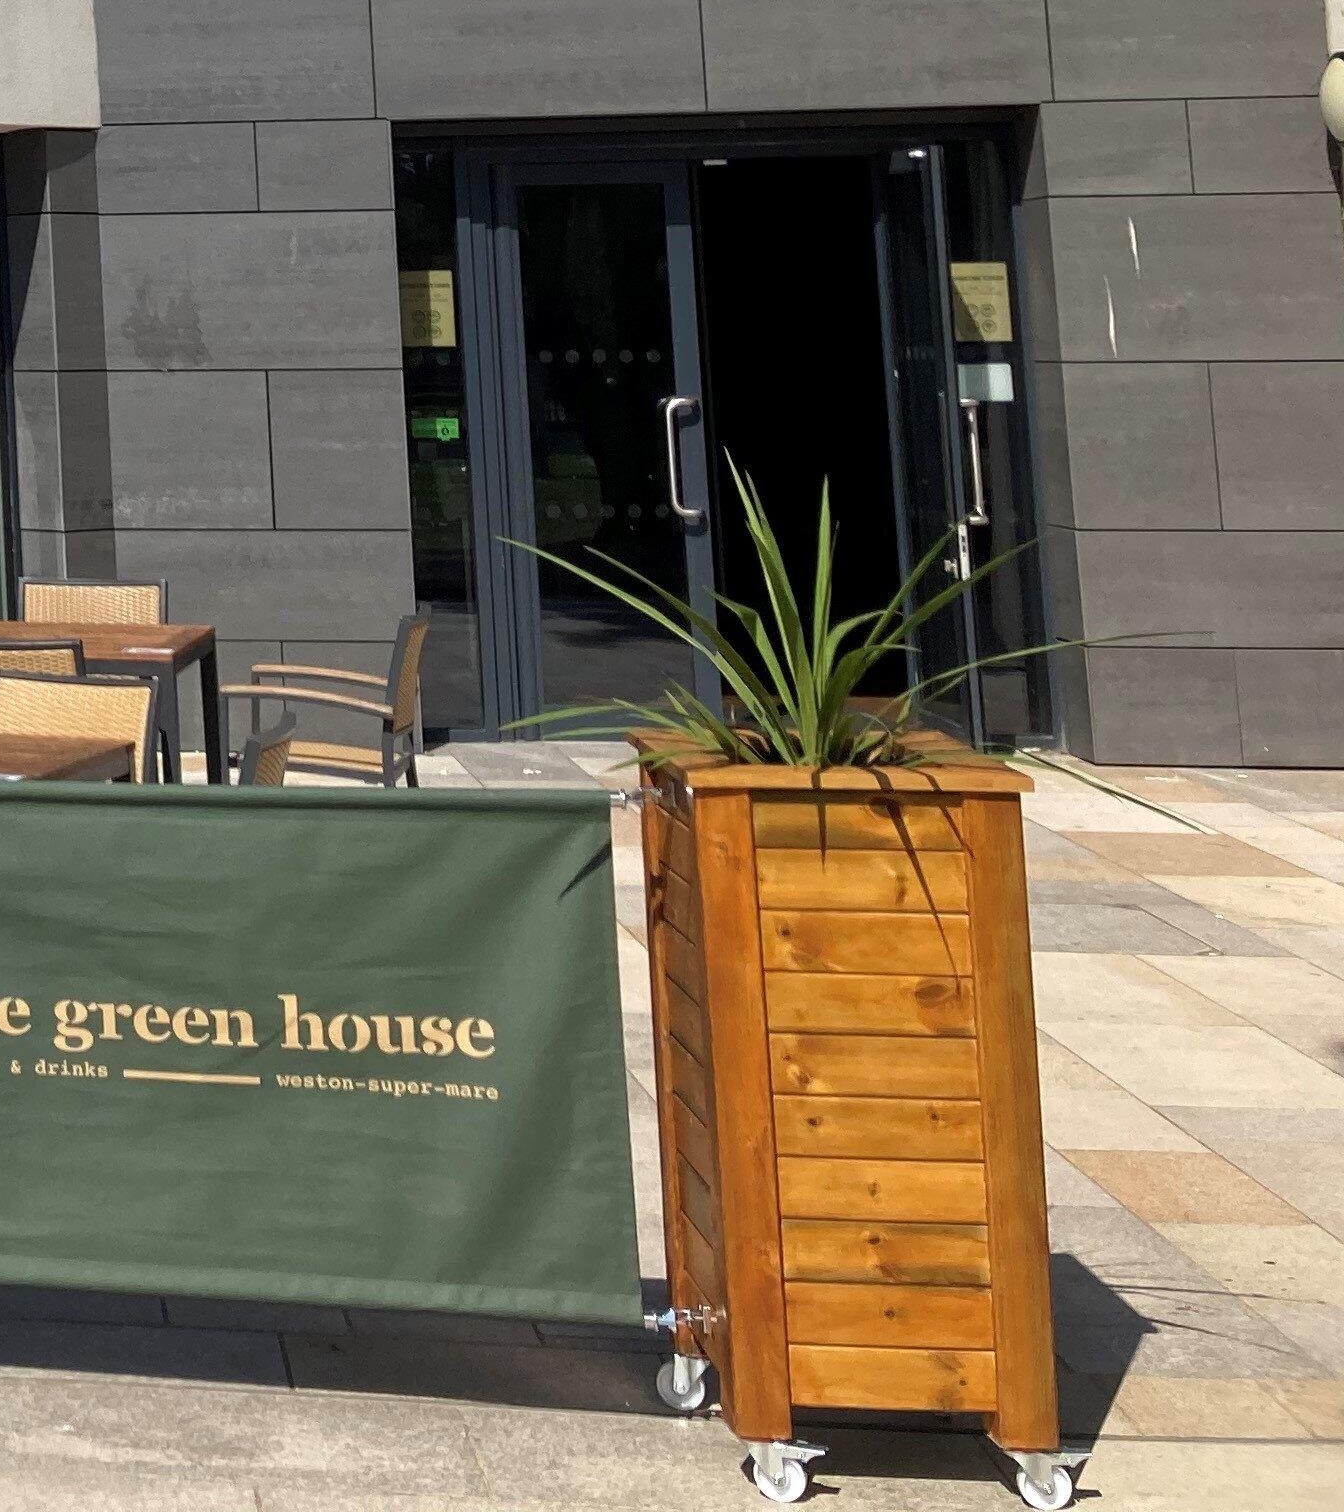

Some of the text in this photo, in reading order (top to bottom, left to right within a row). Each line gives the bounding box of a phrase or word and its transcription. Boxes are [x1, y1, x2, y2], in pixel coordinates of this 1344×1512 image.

[53, 996, 259, 1053] green
[277, 992, 496, 1058] house
[10, 1059, 23, 1075] &
[34, 1056, 109, 1079] drinks
[275, 1071, 500, 1102] weston-super-mare
